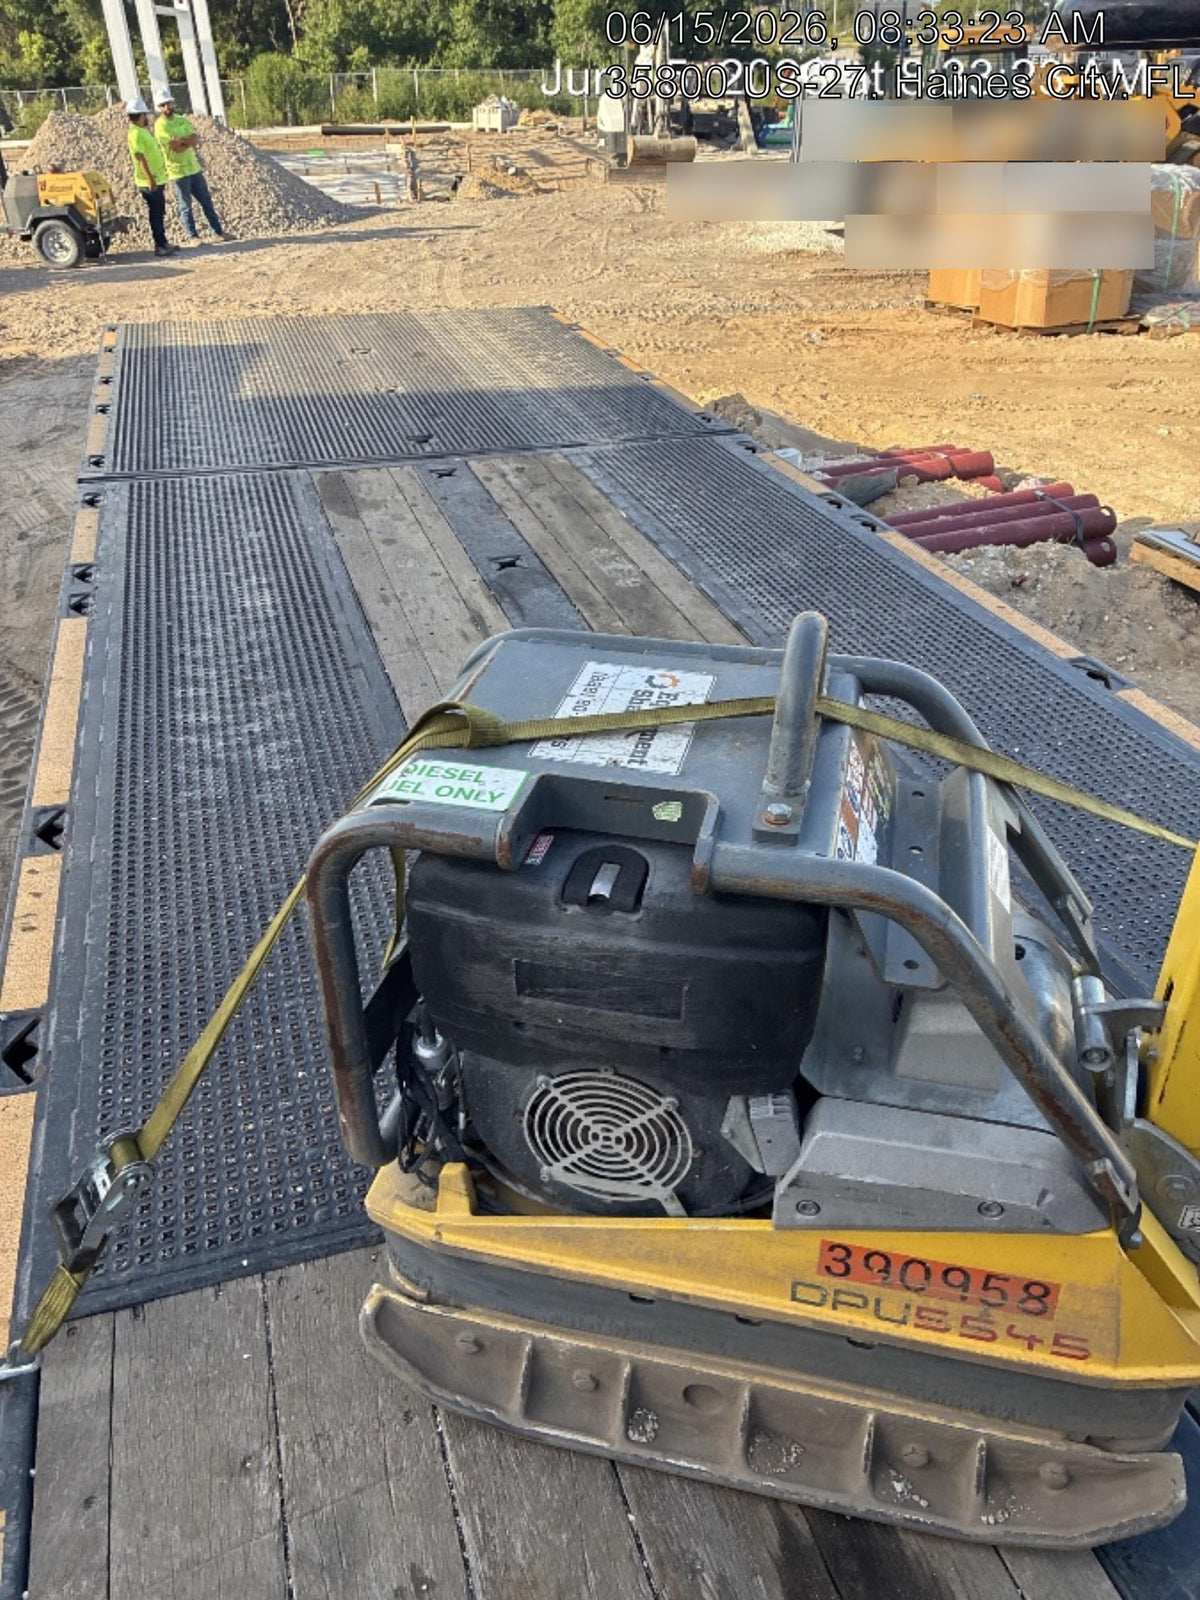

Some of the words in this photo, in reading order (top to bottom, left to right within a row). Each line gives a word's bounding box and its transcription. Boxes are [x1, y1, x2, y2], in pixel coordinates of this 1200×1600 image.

[435, 785, 506, 803] ONLY
[824, 1243, 1052, 1316] 390958
[790, 1280, 1092, 1360] DPU5545
